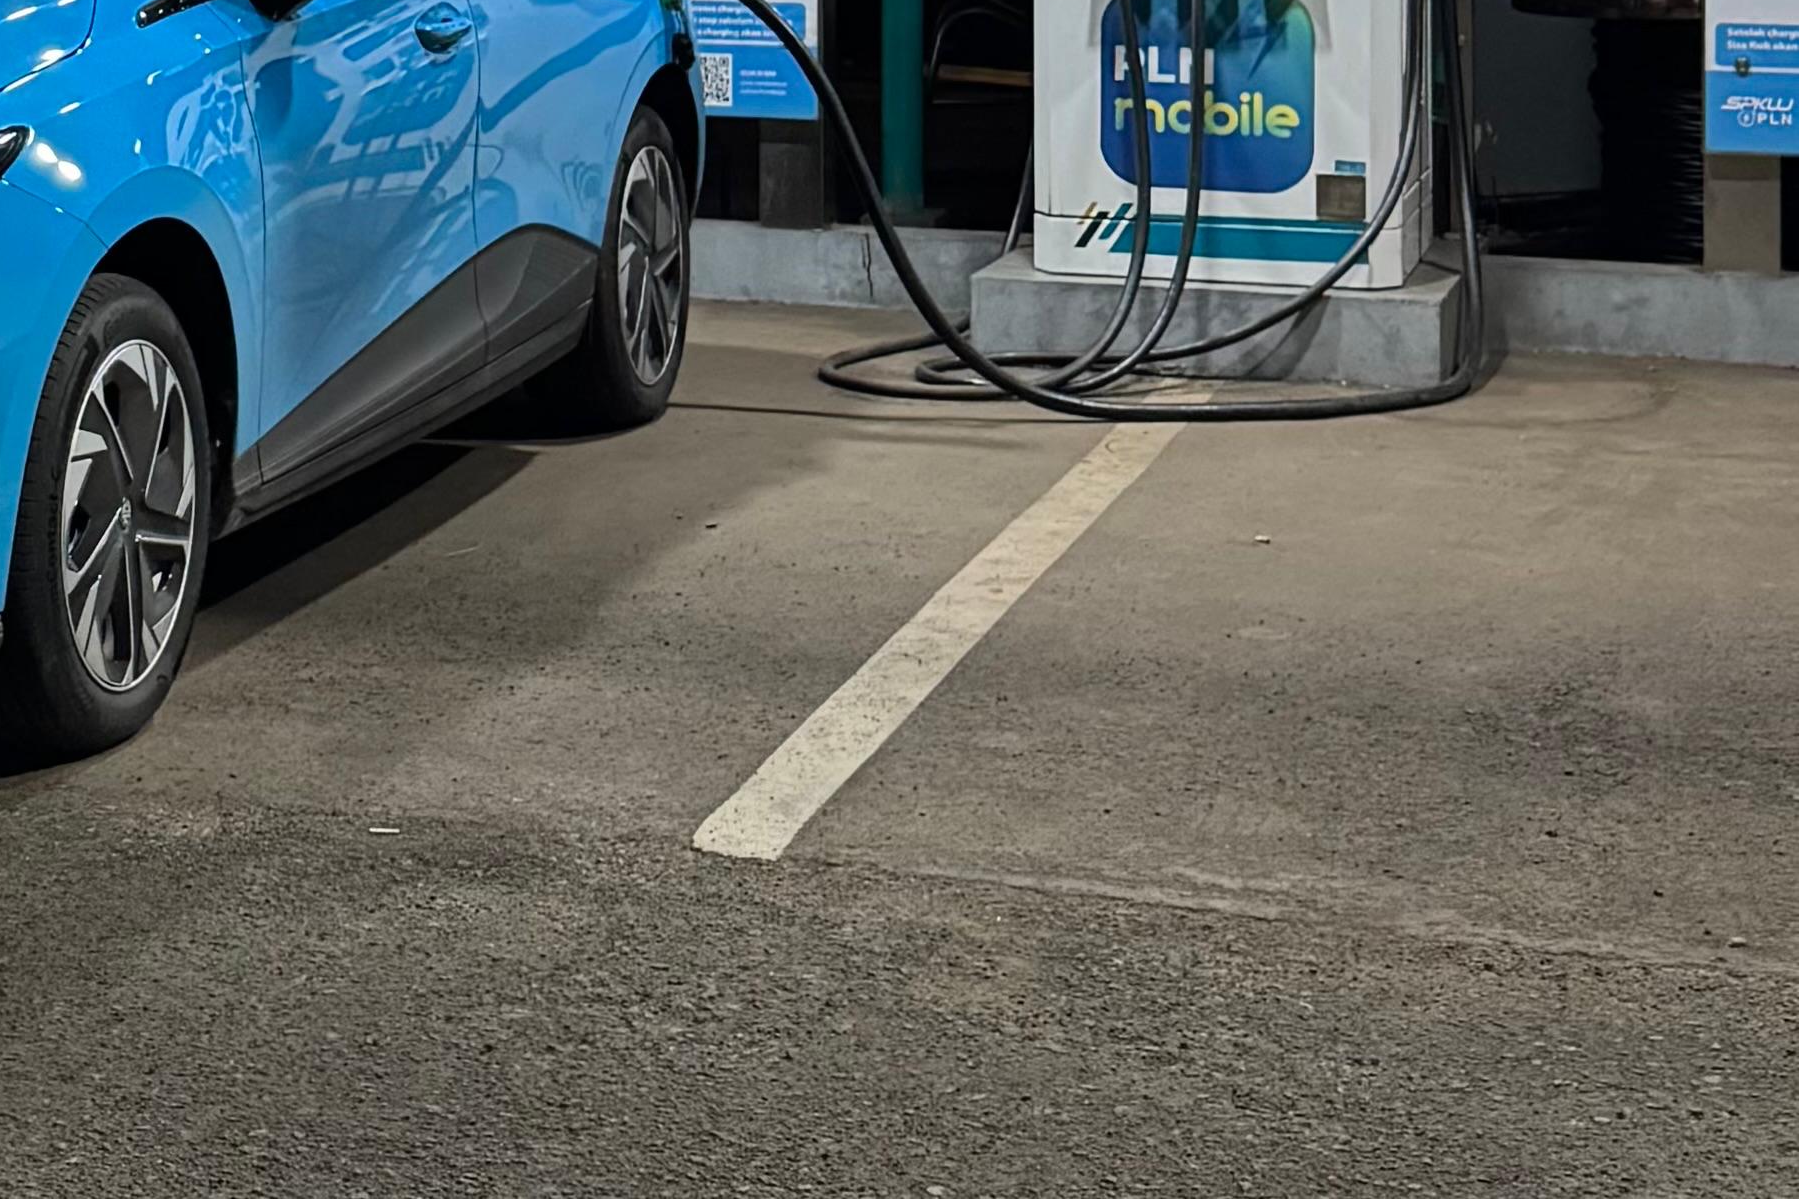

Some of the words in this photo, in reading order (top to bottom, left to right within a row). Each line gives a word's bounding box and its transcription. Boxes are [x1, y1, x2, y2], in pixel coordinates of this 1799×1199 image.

[1721, 95, 1795, 111] SPKLU
[1114, 89, 1299, 138] mobile
[1757, 113, 1793, 125] PLN
